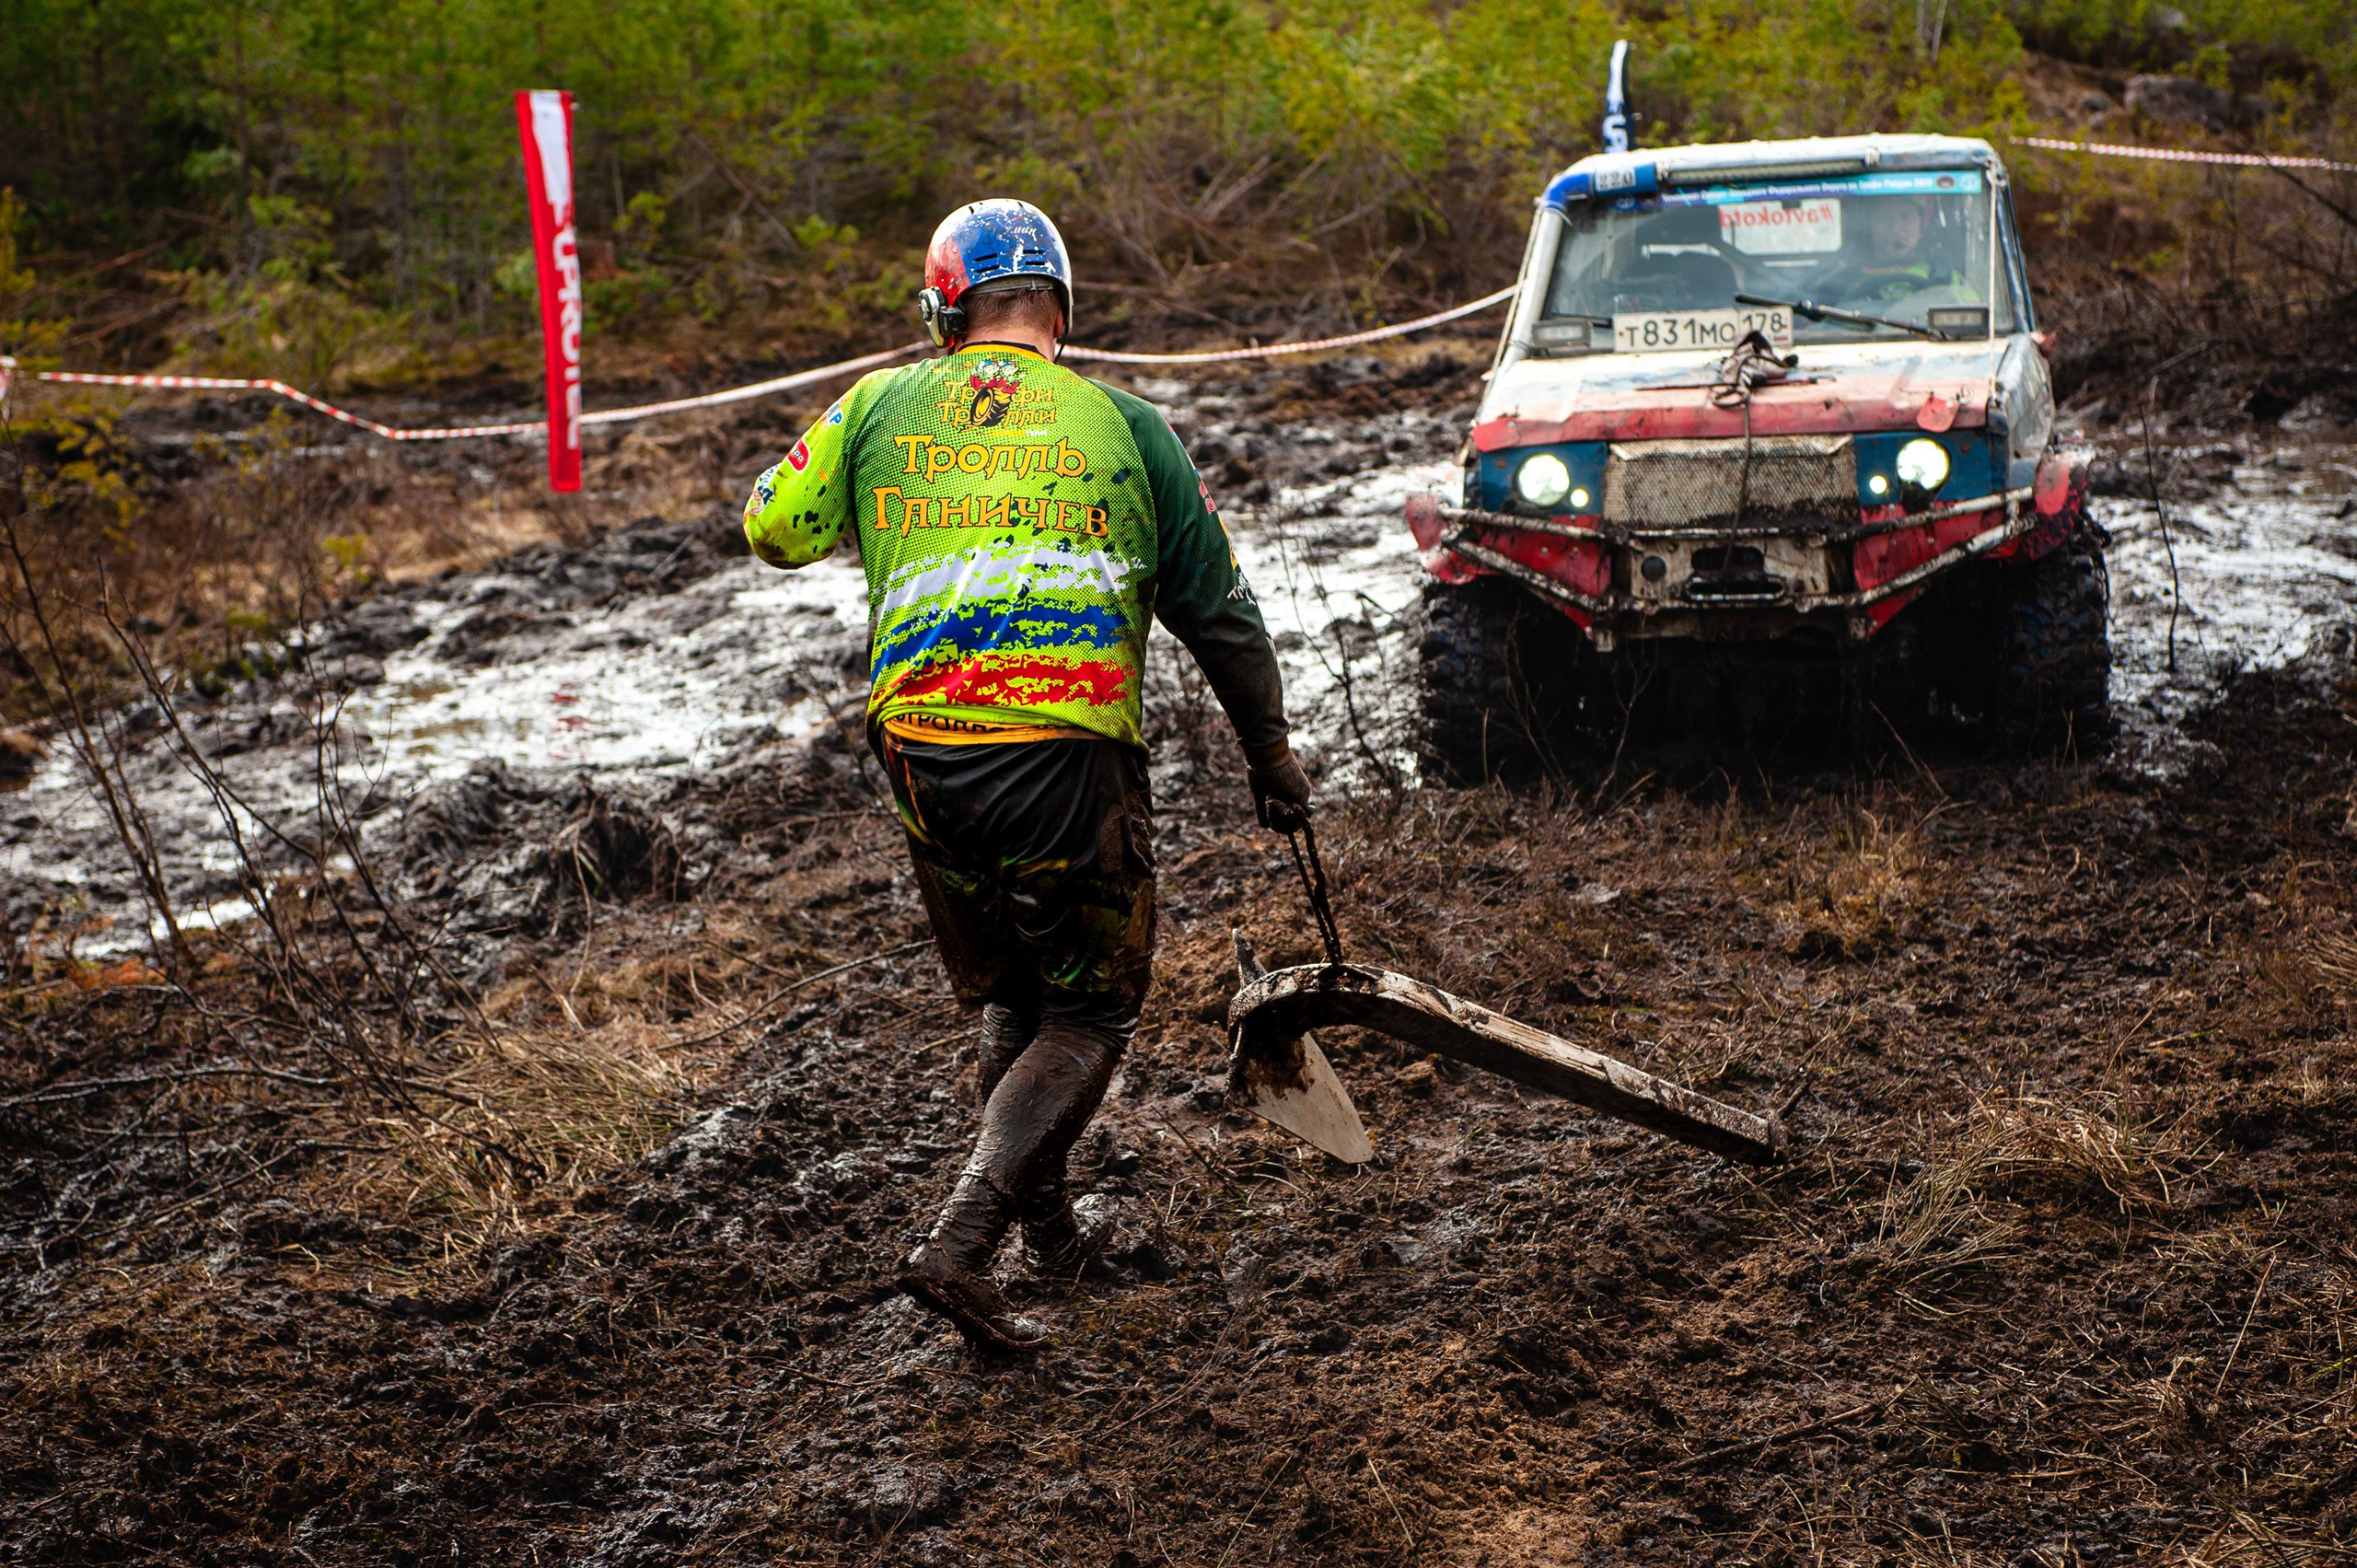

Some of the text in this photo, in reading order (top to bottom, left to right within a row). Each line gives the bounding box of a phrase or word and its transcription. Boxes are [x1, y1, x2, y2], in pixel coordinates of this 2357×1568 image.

[1598, 171, 1632, 188] 220
[1625, 312, 1782, 347] Т831МО 178
[893, 435, 1087, 483] Тролль
